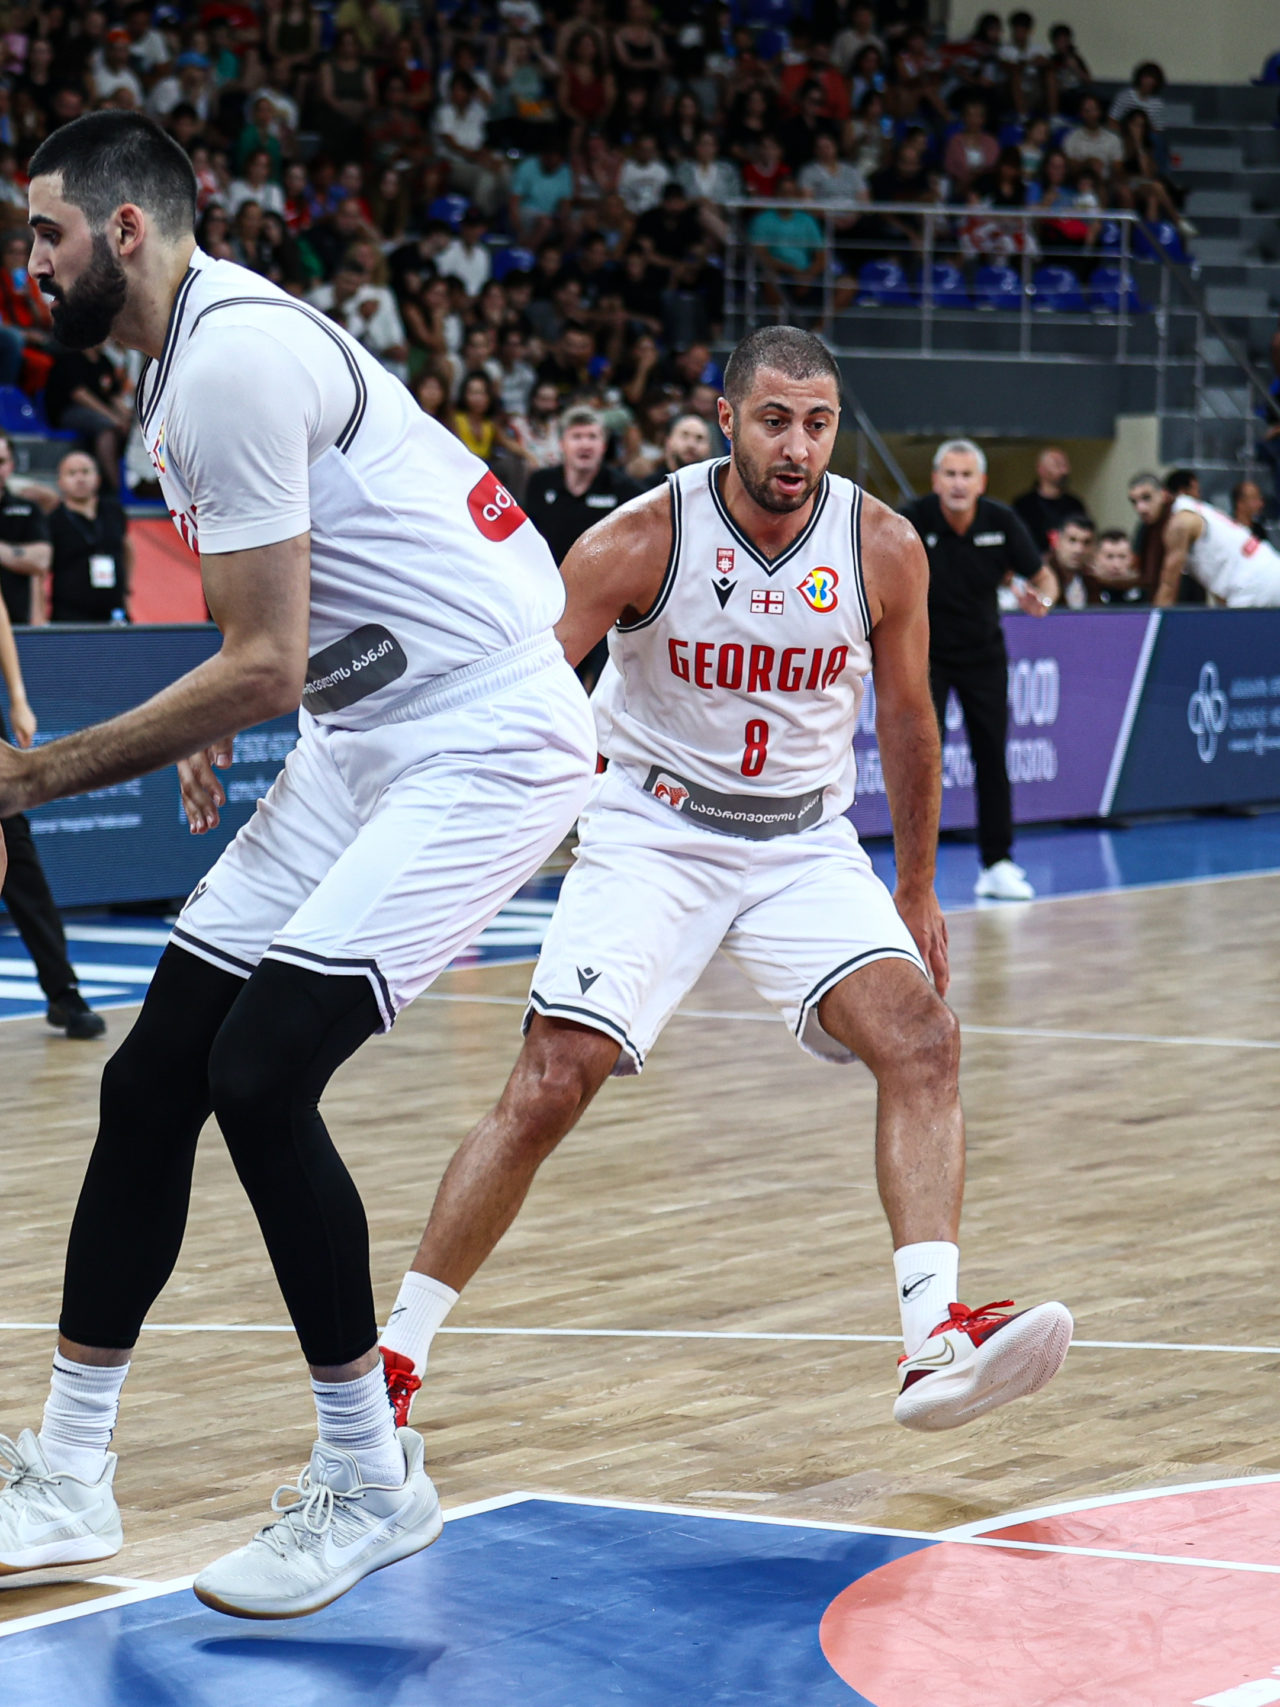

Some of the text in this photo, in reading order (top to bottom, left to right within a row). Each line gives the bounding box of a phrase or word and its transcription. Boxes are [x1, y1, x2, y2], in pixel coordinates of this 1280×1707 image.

[352, 640, 393, 672] ბანკი
[668, 638, 848, 693] GEORGIA
[741, 719, 769, 776] 8
